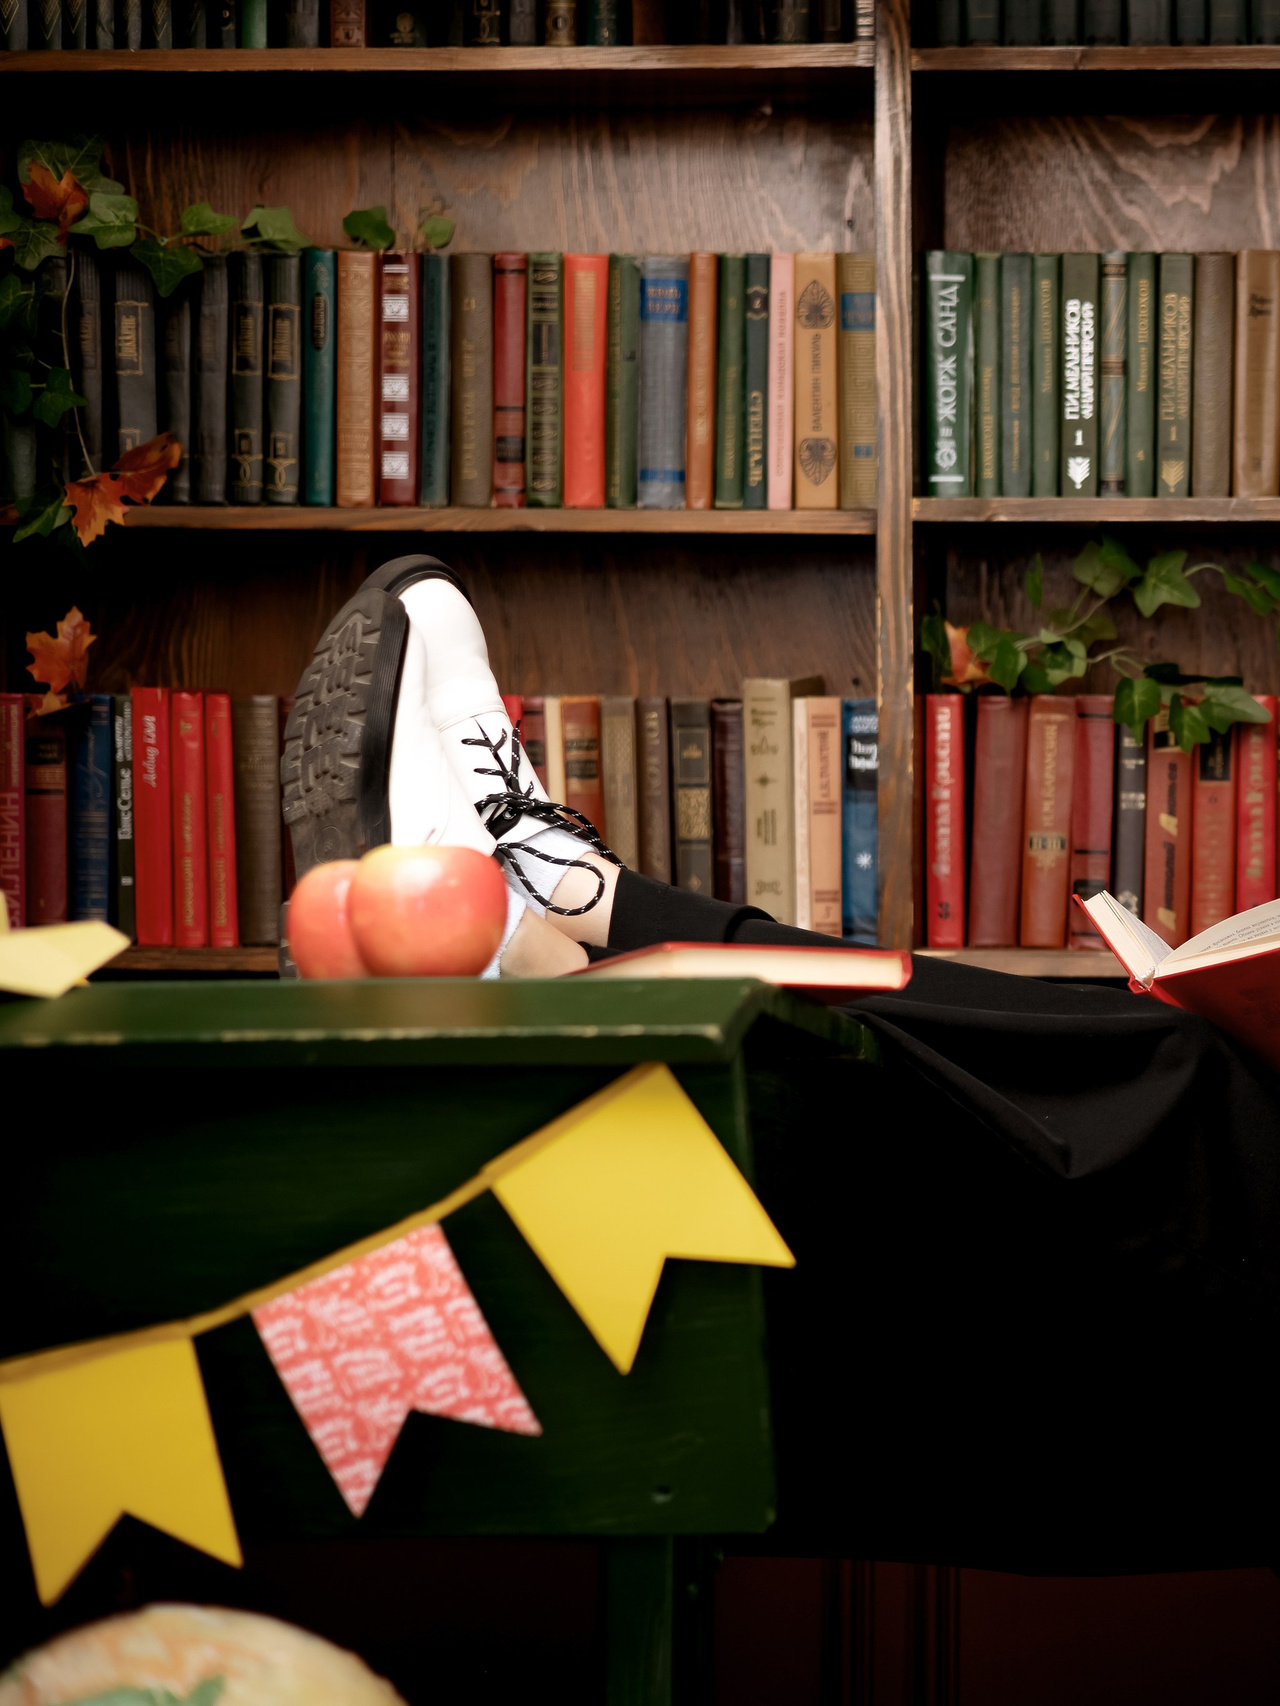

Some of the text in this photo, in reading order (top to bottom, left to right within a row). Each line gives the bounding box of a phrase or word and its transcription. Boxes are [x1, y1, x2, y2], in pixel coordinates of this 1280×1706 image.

[811, 333, 823, 432] ВАЛЕНТИН ПИКУЛЬ
[936, 283, 960, 423] ЖОРЖ САНД
[1064, 299, 1081, 391] МЕЛЬНИКОВ
[1161, 292, 1179, 389] МЕЛЬНИКОВ
[747, 390, 764, 487] СТЕНДАЛЬ
